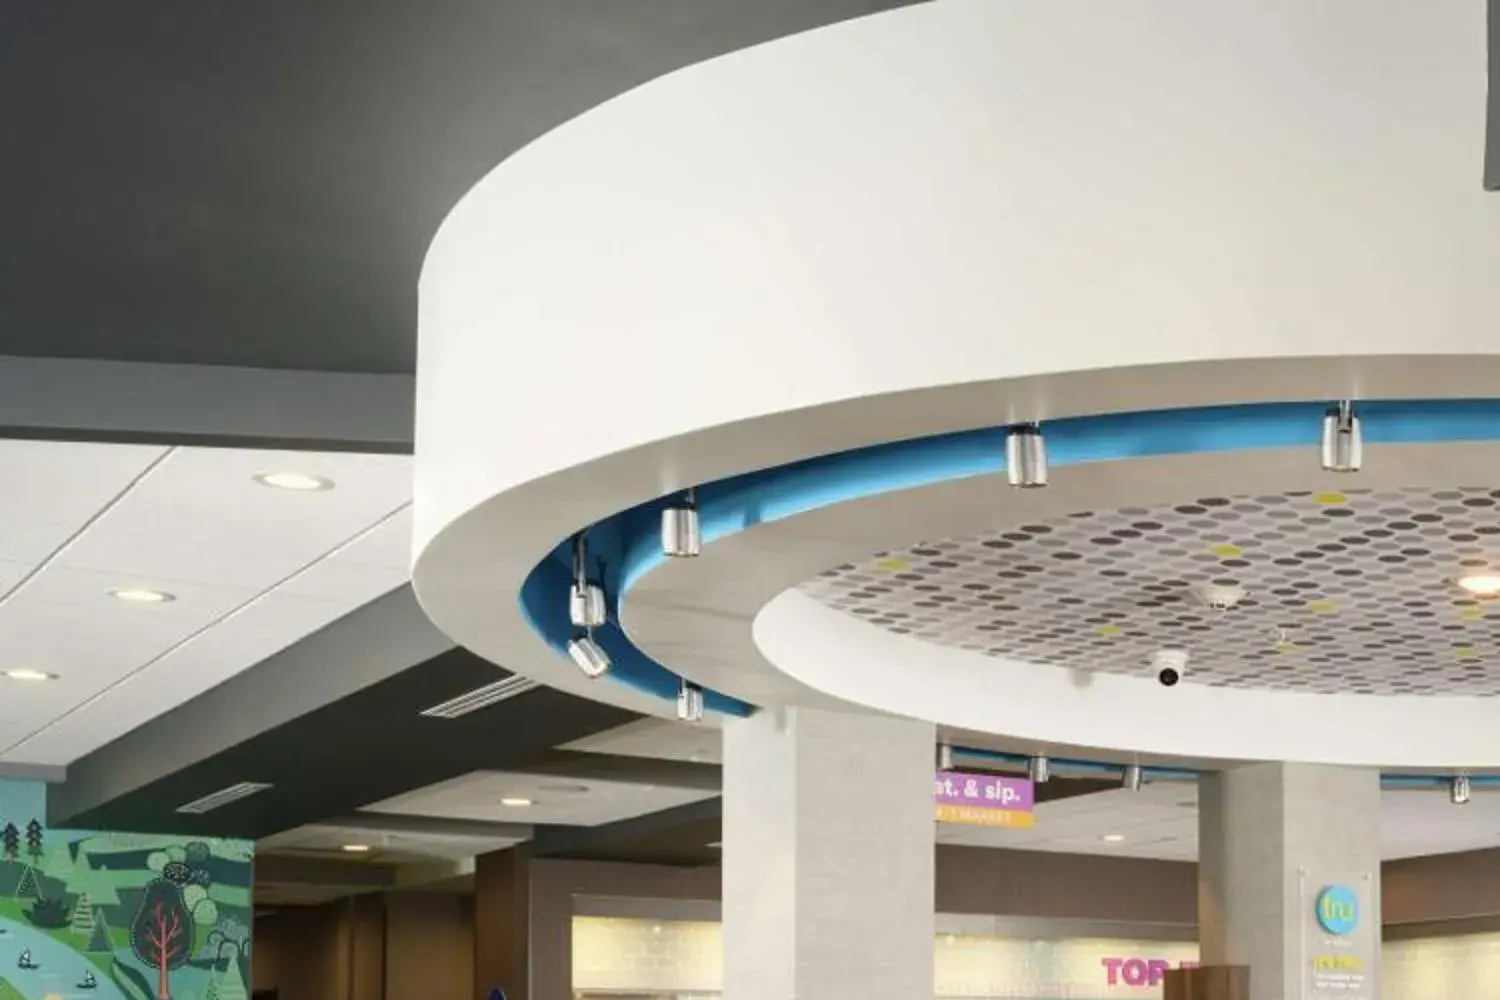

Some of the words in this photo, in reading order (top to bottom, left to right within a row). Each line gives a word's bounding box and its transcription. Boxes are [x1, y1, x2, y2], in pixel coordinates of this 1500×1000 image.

[935, 779, 960, 797] at.
[963, 779, 979, 798] &
[985, 780, 1021, 805] sip.
[1324, 897, 1355, 921] tru
[1101, 958, 1169, 986] TOP
